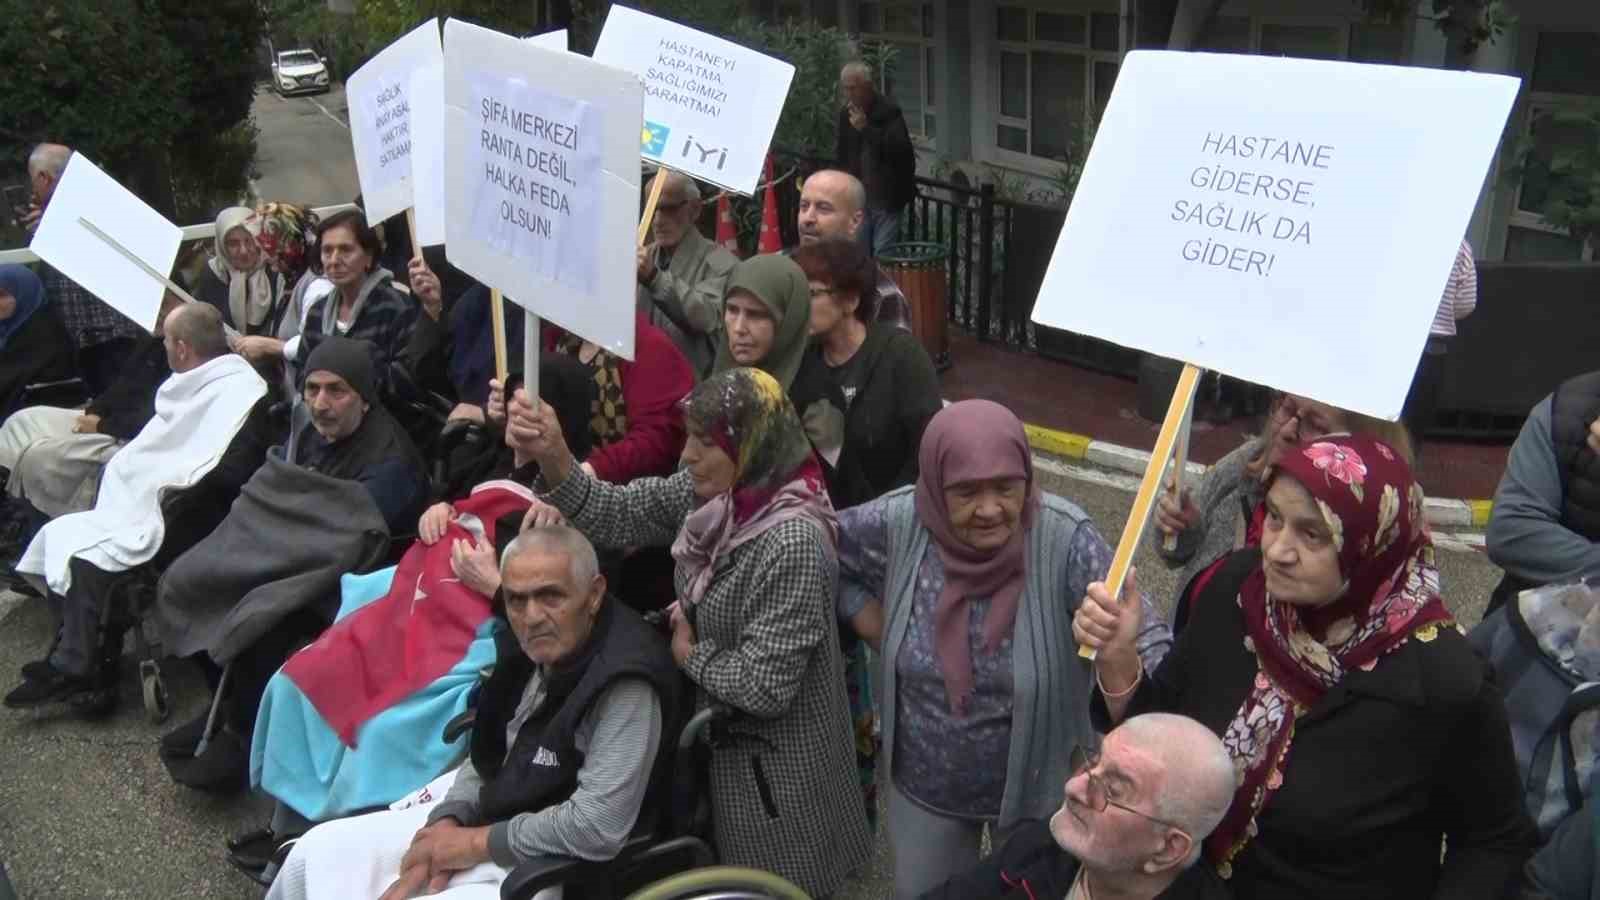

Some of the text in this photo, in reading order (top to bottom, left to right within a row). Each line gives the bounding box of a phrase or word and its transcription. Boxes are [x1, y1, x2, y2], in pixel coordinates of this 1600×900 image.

[480, 96, 578, 152] ŞİFA MERKEZİ
[480, 129, 577, 188] RANTA DEĞİL,
[1201, 132, 1335, 169] HASTANE
[485, 162, 571, 217] HALKA FEDA
[1190, 164, 1316, 208] GİDERSE,
[500, 199, 552, 240] OLSUN!
[1170, 200, 1311, 245] SAĞLIK DA
[1181, 237, 1276, 278] GİDER!
